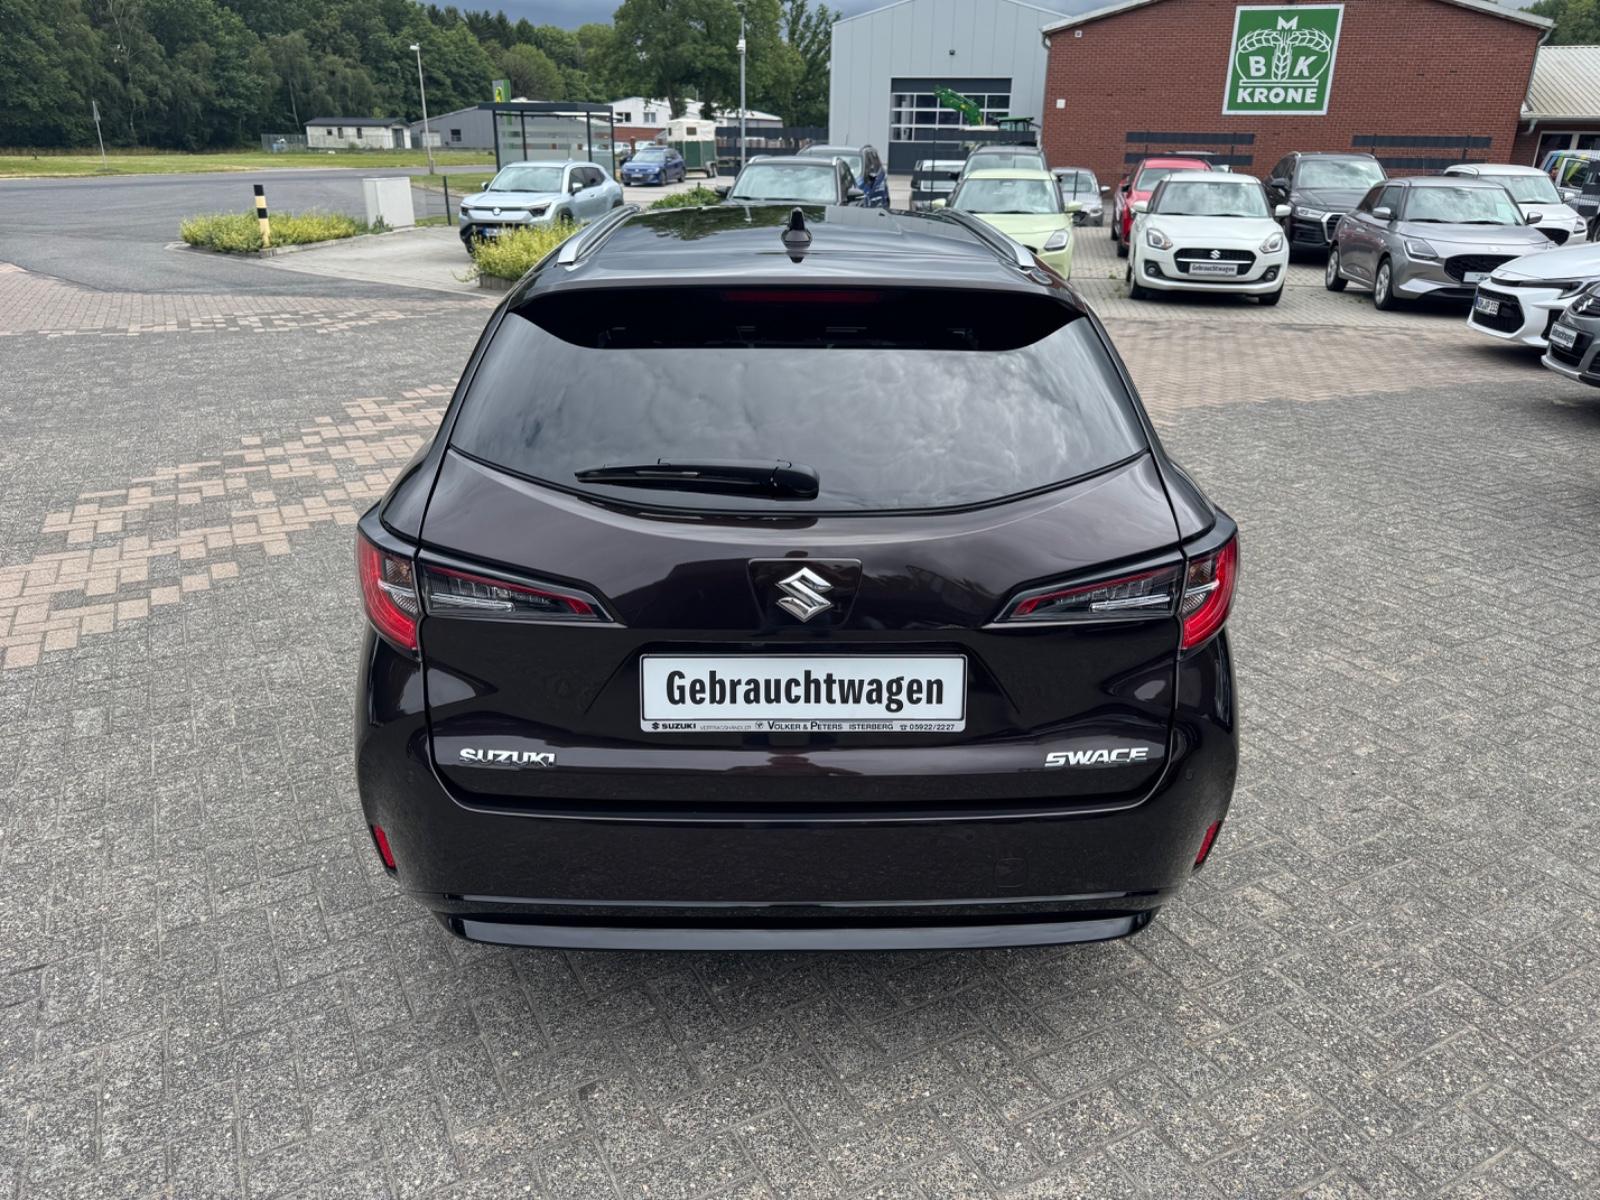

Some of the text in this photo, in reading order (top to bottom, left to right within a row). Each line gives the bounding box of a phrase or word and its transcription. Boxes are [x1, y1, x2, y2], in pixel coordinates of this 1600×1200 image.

[1277, 15, 1299, 30] M
[1248, 55, 1318, 77] B K
[1236, 87, 1318, 104] KRONE
[666, 670, 944, 713] Gebrauchtwagen
[460, 747, 556, 767] SUZUKI
[1044, 747, 1149, 768] SWACE
